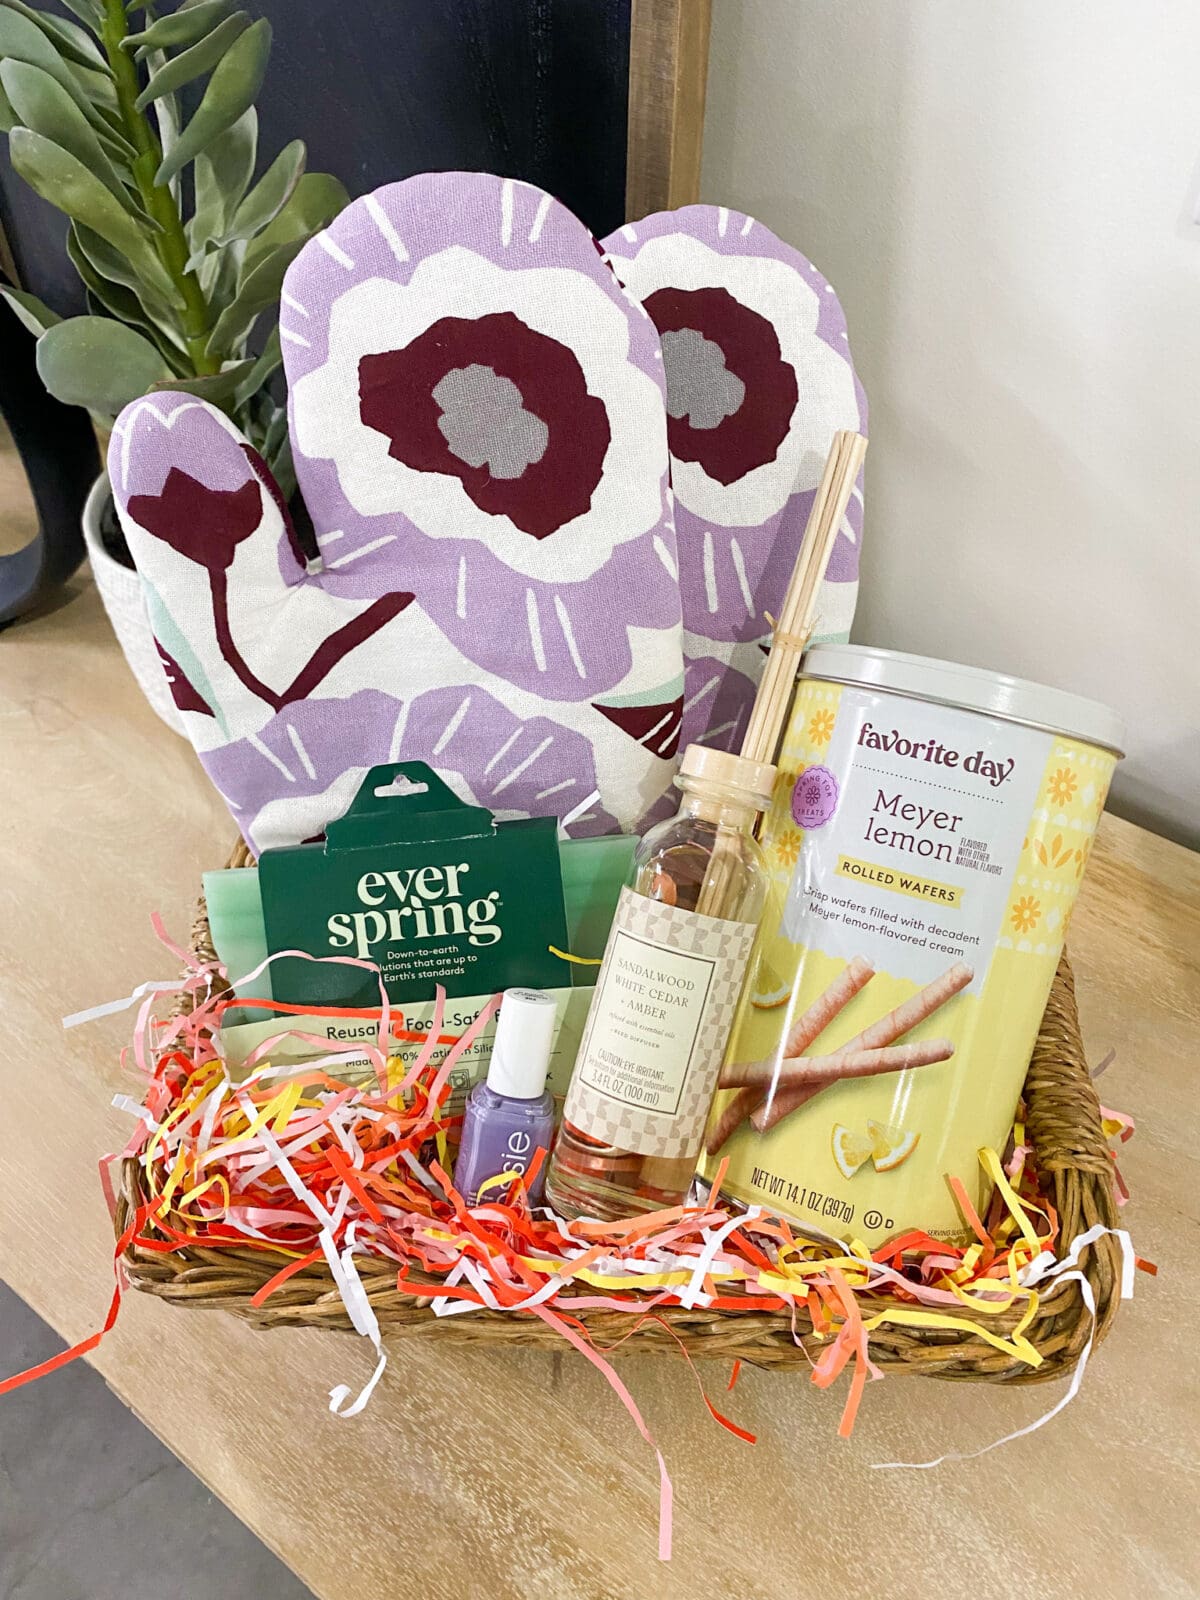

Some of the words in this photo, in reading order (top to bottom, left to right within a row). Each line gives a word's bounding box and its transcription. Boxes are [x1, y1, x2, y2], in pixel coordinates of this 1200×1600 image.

[857, 722, 960, 768] favorite
[963, 750, 1015, 787] day
[872, 789, 963, 832] Meyer
[863, 817, 953, 863] lemon
[957, 846, 973, 858] WITH
[972, 850, 990, 863] OTHER
[960, 837, 988, 852] FLAVORED
[954, 855, 979, 870] NATURAL
[357, 862, 470, 906] ever
[842, 861, 894, 884] ROLLED
[900, 877, 955, 902] WAFERS
[803, 885, 829, 902] Crisp
[831, 897, 867, 914] wafers
[869, 906, 898, 923] filled
[901, 918, 925, 931] with
[927, 924, 981, 945] decadent
[809, 902, 841, 921] Meyer
[842, 914, 927, 947] lemon-flavored
[929, 941, 965, 957] cream
[379, 960, 411, 972] lutions
[413, 959, 434, 968] that
[436, 958, 452, 966] are
[453, 956, 466, 966] up
[467, 955, 478, 963] to
[387, 945, 459, 960] Down-to-earth
[383, 971, 416, 983] Earth's
[418, 967, 465, 978] standards
[615, 973, 646, 995] WHITE
[648, 988, 689, 1008] CEDAR
[617, 958, 695, 991] SANDALWOOD
[627, 1000, 667, 1020] AMBER
[612, 1079, 624, 1094] OZ
[751, 1167, 770, 1190] NET
[768, 1175, 786, 1198] WT
[786, 1183, 807, 1206] 14.1
[807, 1191, 823, 1212] OZ
[821, 1196, 855, 1224] (397g)
